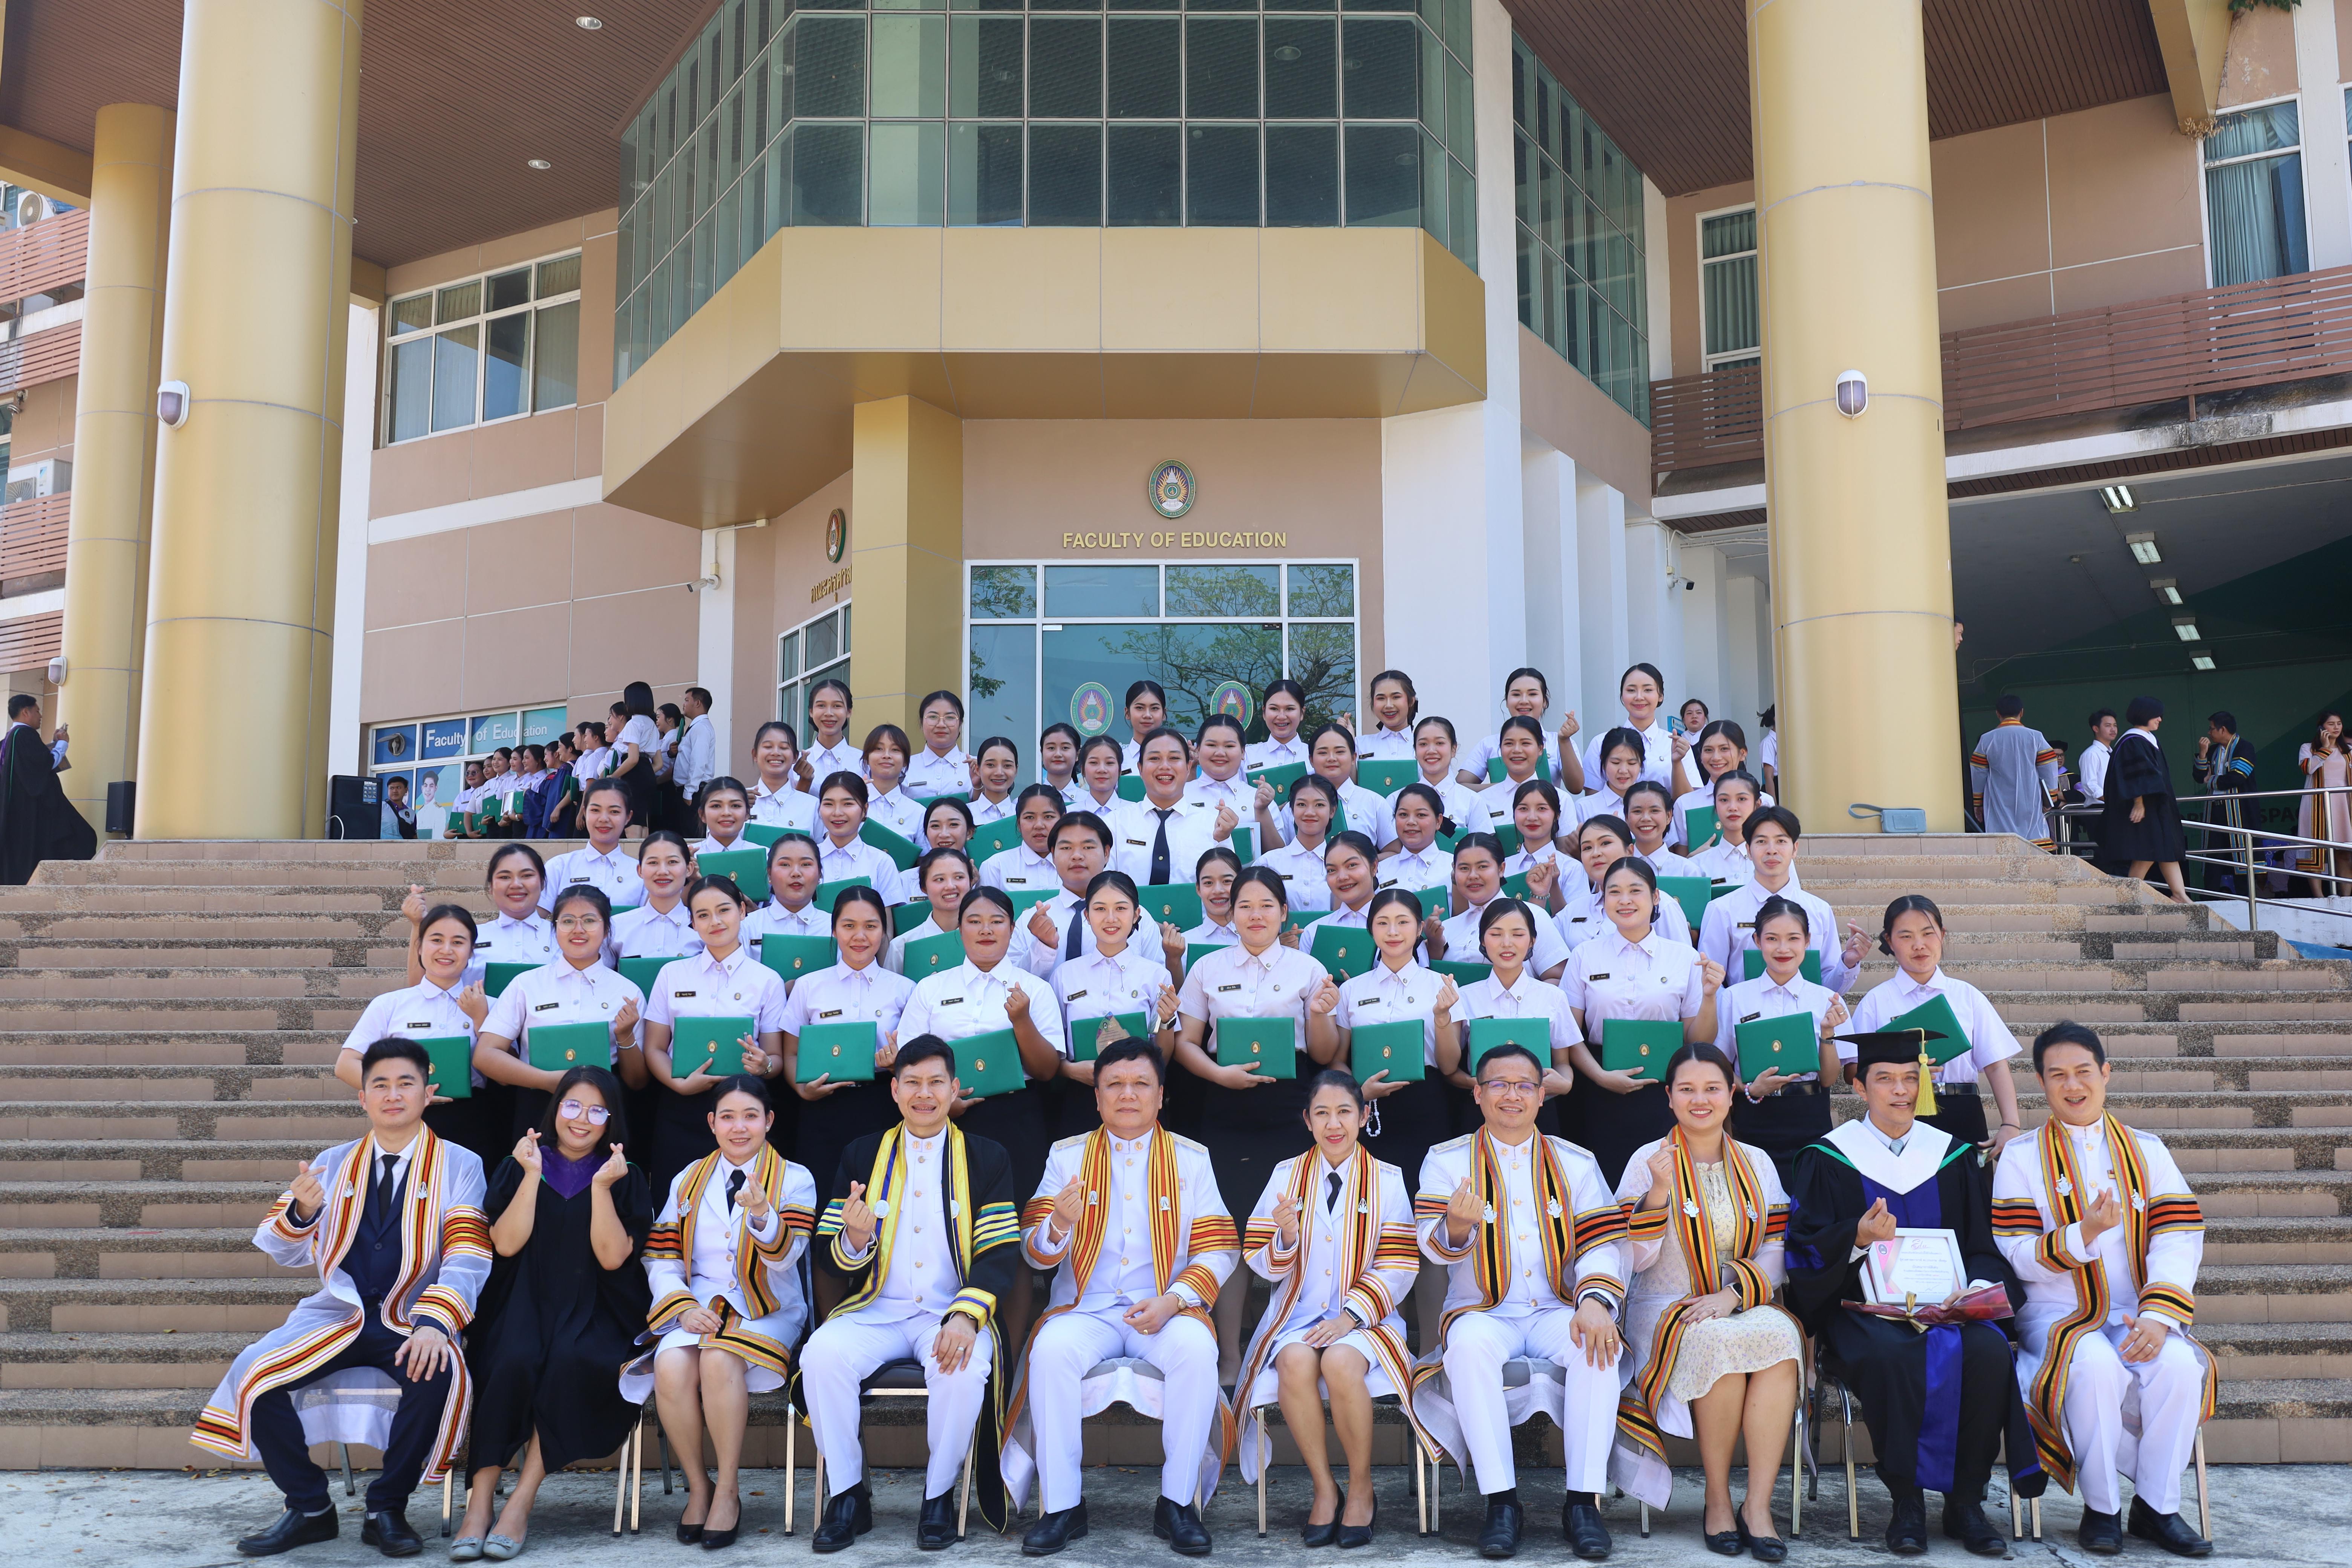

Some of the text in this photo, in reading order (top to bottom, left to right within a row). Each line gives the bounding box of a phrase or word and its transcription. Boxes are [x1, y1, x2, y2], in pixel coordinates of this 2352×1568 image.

[1063, 531, 1286, 548] FACULTY OF EDUCATION
[426, 729, 466, 748] Faculty
[475, 727, 488, 742] of
